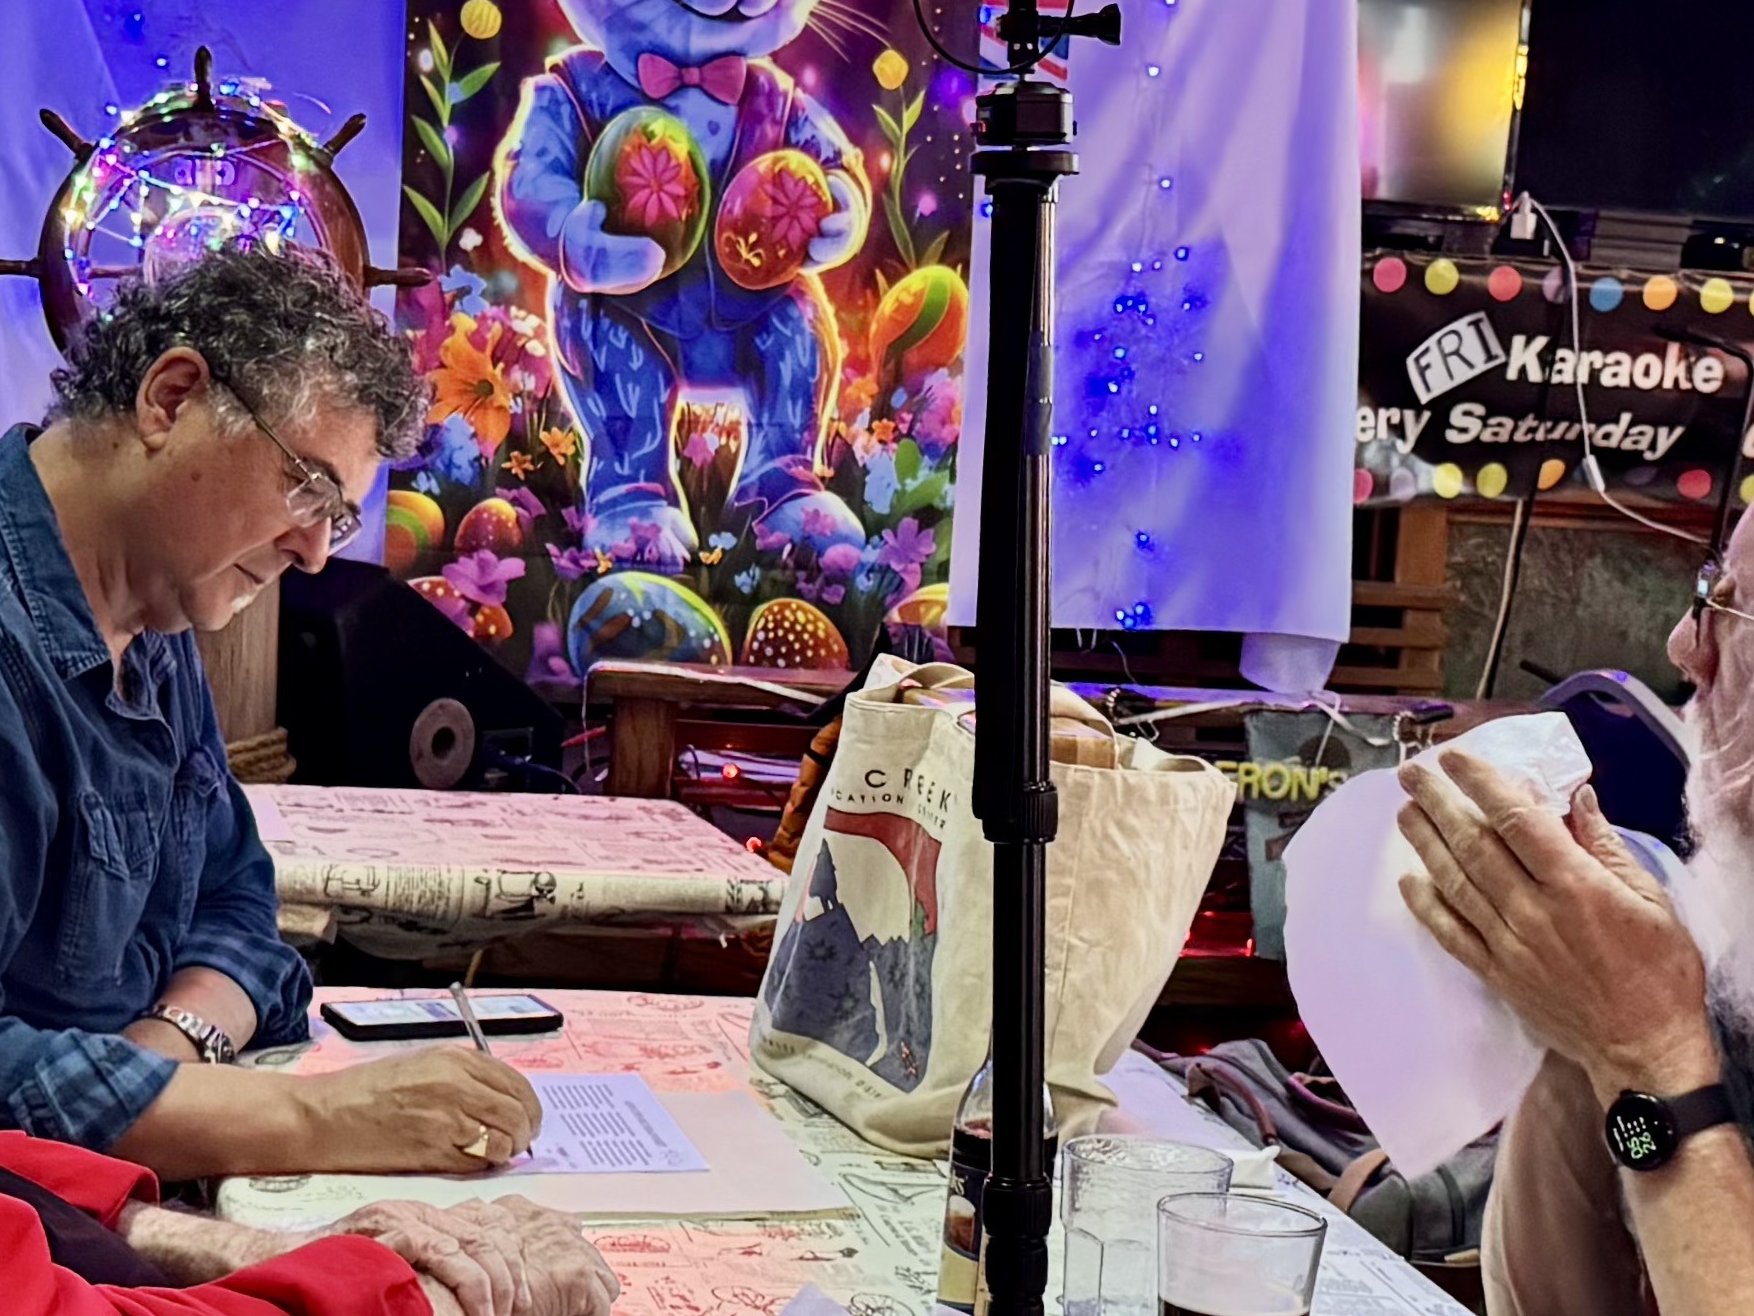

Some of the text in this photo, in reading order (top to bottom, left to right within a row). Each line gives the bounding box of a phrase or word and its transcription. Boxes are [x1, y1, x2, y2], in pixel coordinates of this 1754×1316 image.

[1412, 316, 1502, 394] FRI
[1506, 334, 1725, 394] Karaoke
[1444, 402, 1685, 461] Saturday
